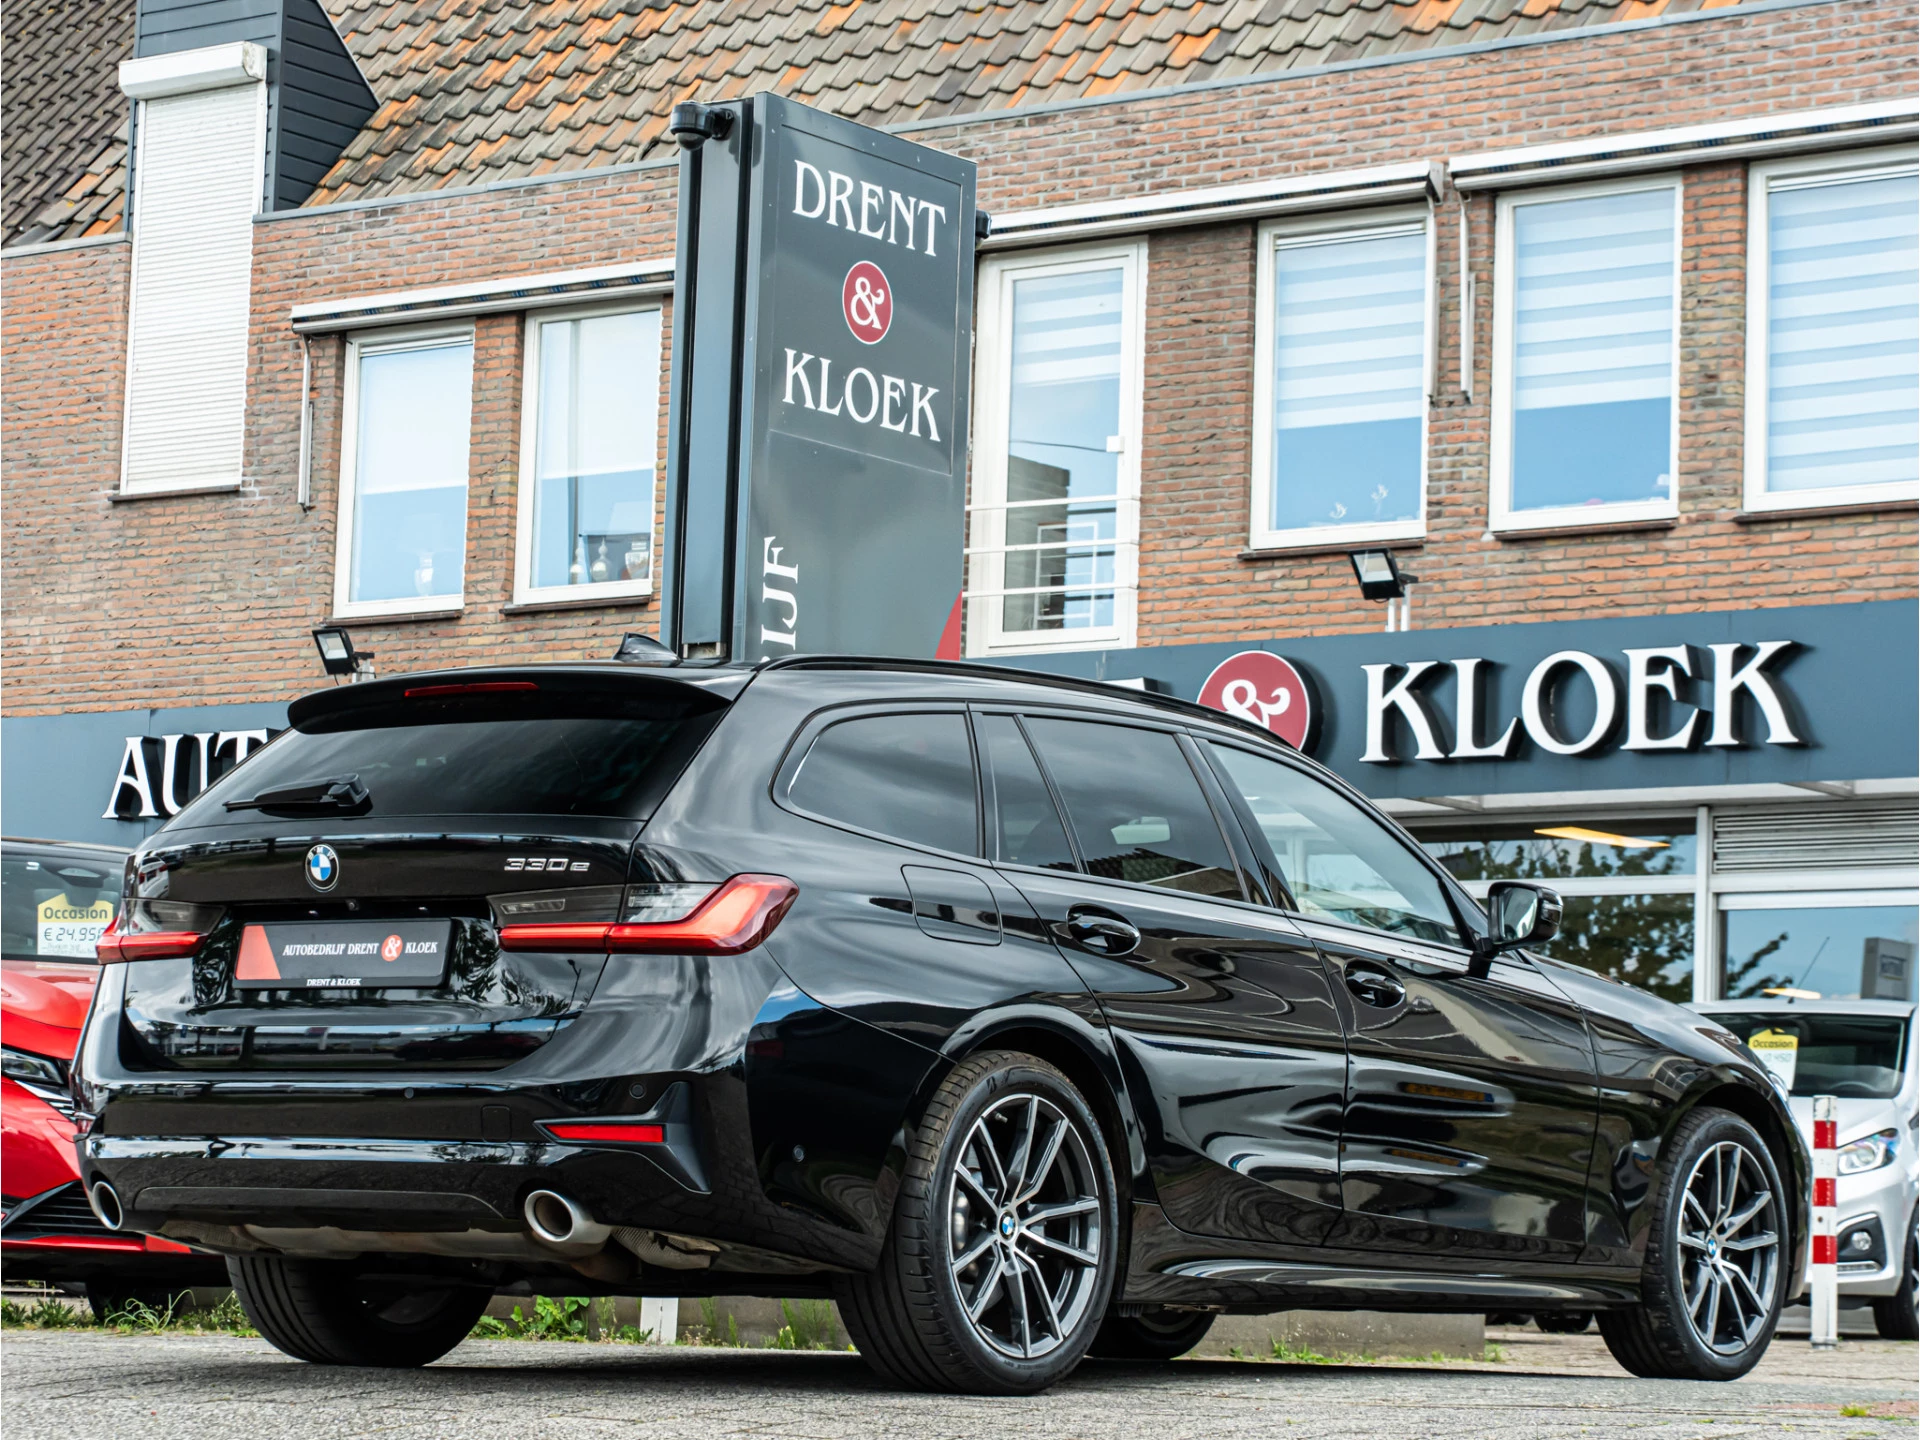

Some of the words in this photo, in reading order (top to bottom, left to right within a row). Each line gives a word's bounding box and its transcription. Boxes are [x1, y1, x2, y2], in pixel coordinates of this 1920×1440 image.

[792, 159, 947, 257] DRENT
[849, 275, 885, 330] &
[781, 347, 941, 443] KLOEK
[760, 536, 799, 662] IJF
[1358, 640, 1800, 763] KLOEK
[503, 857, 591, 872] 330e
[43, 907, 108, 920] Occasion
[282, 943, 346, 956] AUTOBEDRIJF
[347, 942, 380, 955] DRENT
[384, 937, 401, 958] &
[404, 941, 438, 954] KLOEK
[306, 978, 331, 987] DRENT
[337, 978, 362, 986] KLOEK
[1752, 1039, 1794, 1048] Occasion
